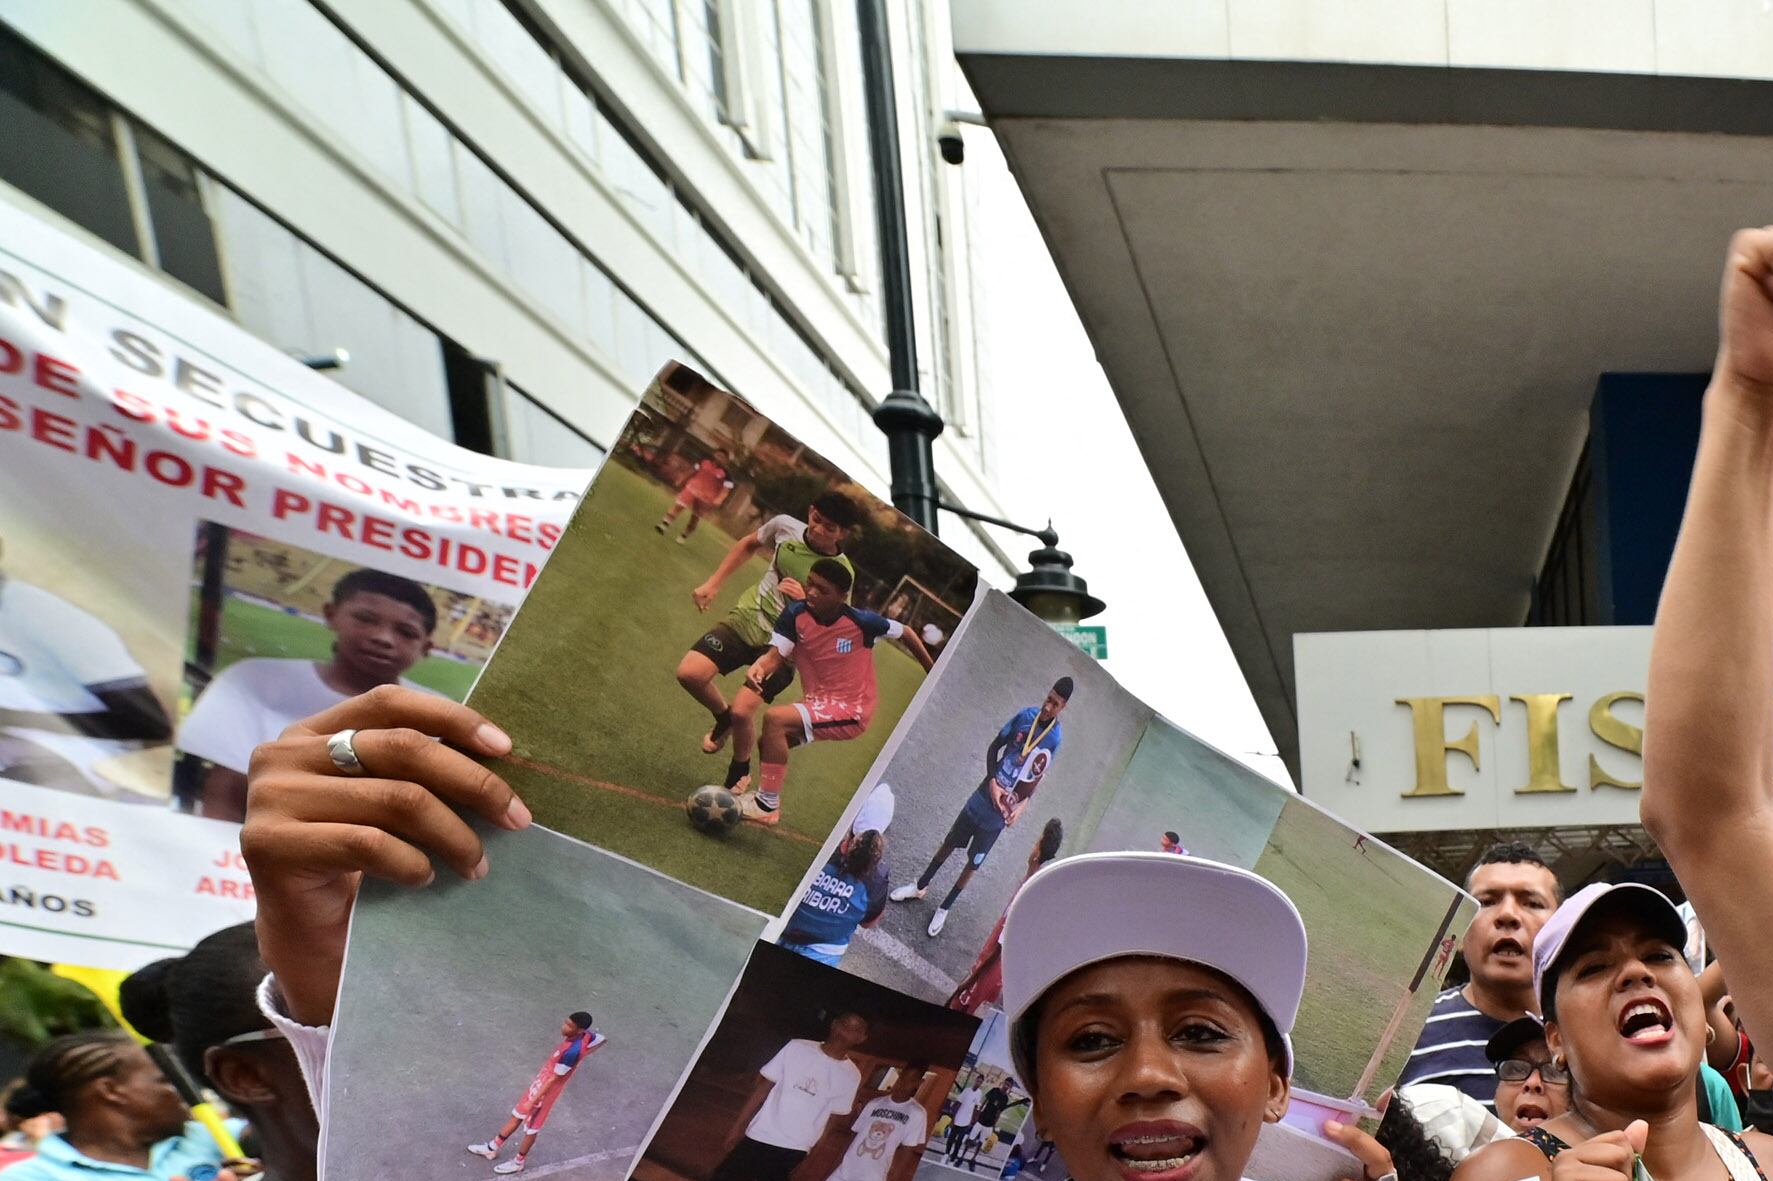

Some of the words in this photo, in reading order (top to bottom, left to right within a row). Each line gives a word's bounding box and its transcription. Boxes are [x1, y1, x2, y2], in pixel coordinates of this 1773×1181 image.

[107, 387, 258, 459] SUS
[0, 843, 121, 881] LEDA
[0, 884, 96, 918] ÑOS
[812, 871, 855, 899] BARRA
